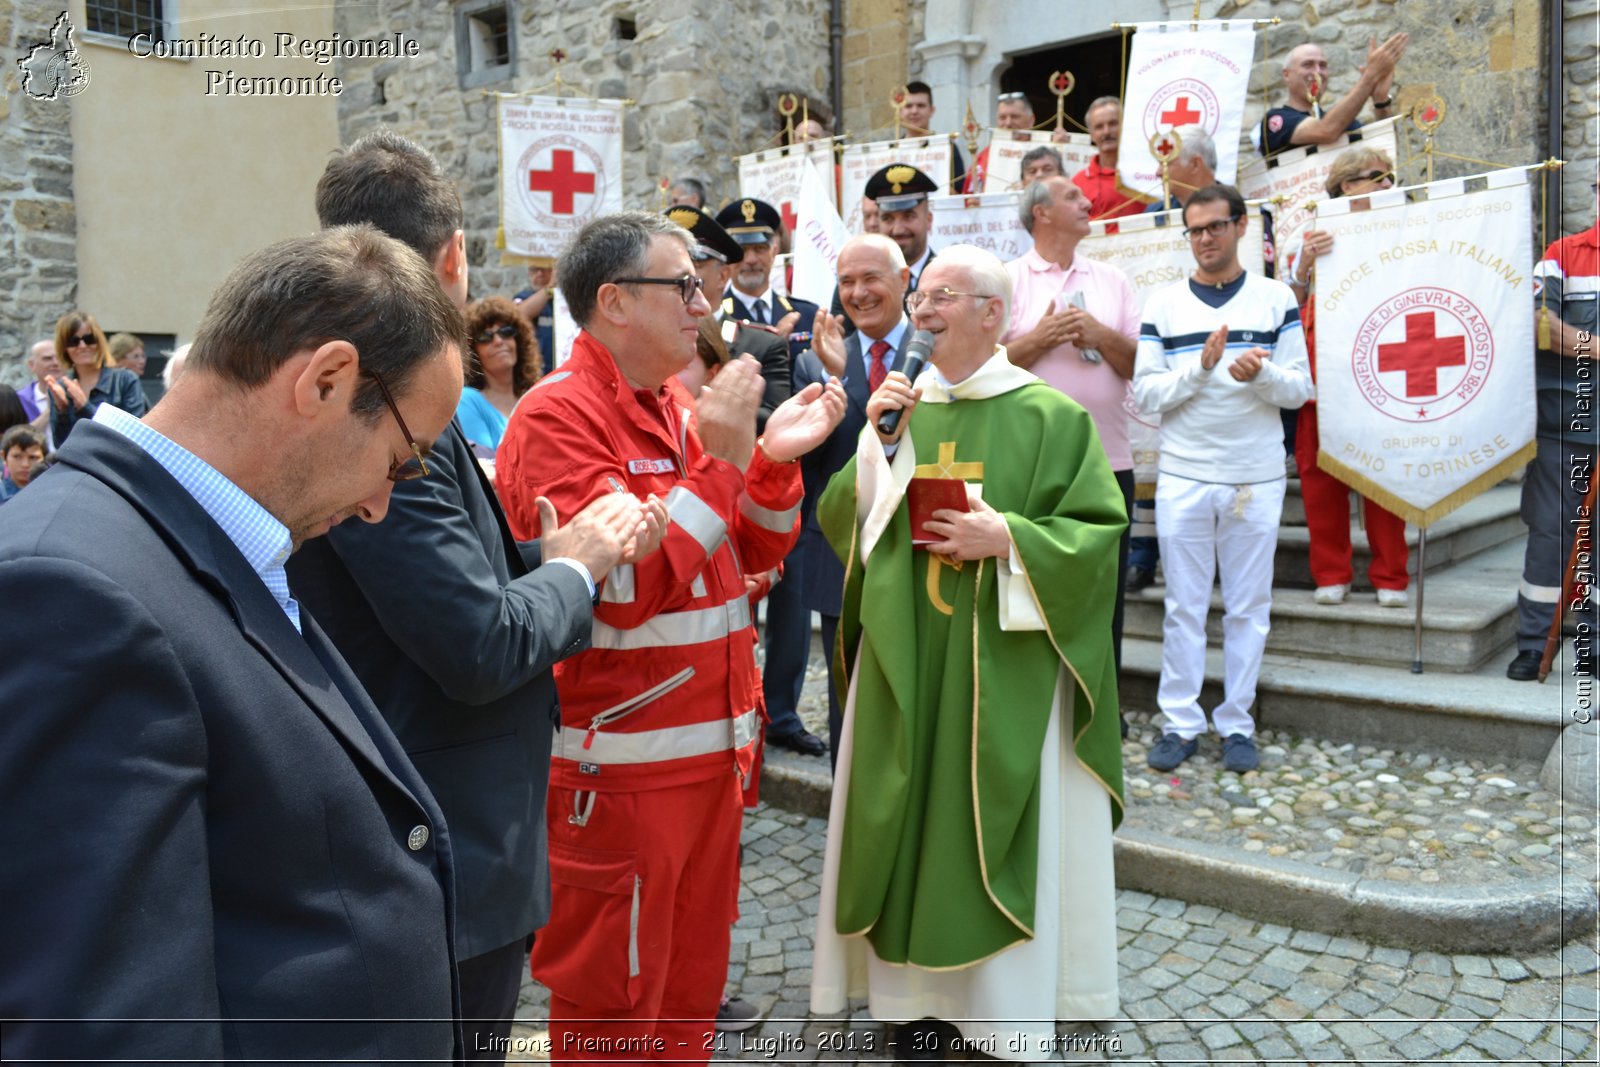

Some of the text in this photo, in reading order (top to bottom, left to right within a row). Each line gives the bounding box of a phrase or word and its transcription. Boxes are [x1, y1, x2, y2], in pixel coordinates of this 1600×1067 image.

[937, 222, 983, 236] VOLONTARI
[1331, 200, 1513, 238] VOLONTARI DEL SOCCORSO
[1135, 265, 1187, 289] ROSSA
[1323, 239, 1524, 313] CROCE ROSSA ITALIANA
[1355, 291, 1490, 408] CONVENZIONE DI GINEVRA 22 AGOSTO 1864
[1343, 434, 1511, 479] PINO TORINESE
[1382, 434, 1463, 450] GRUPPO DI
